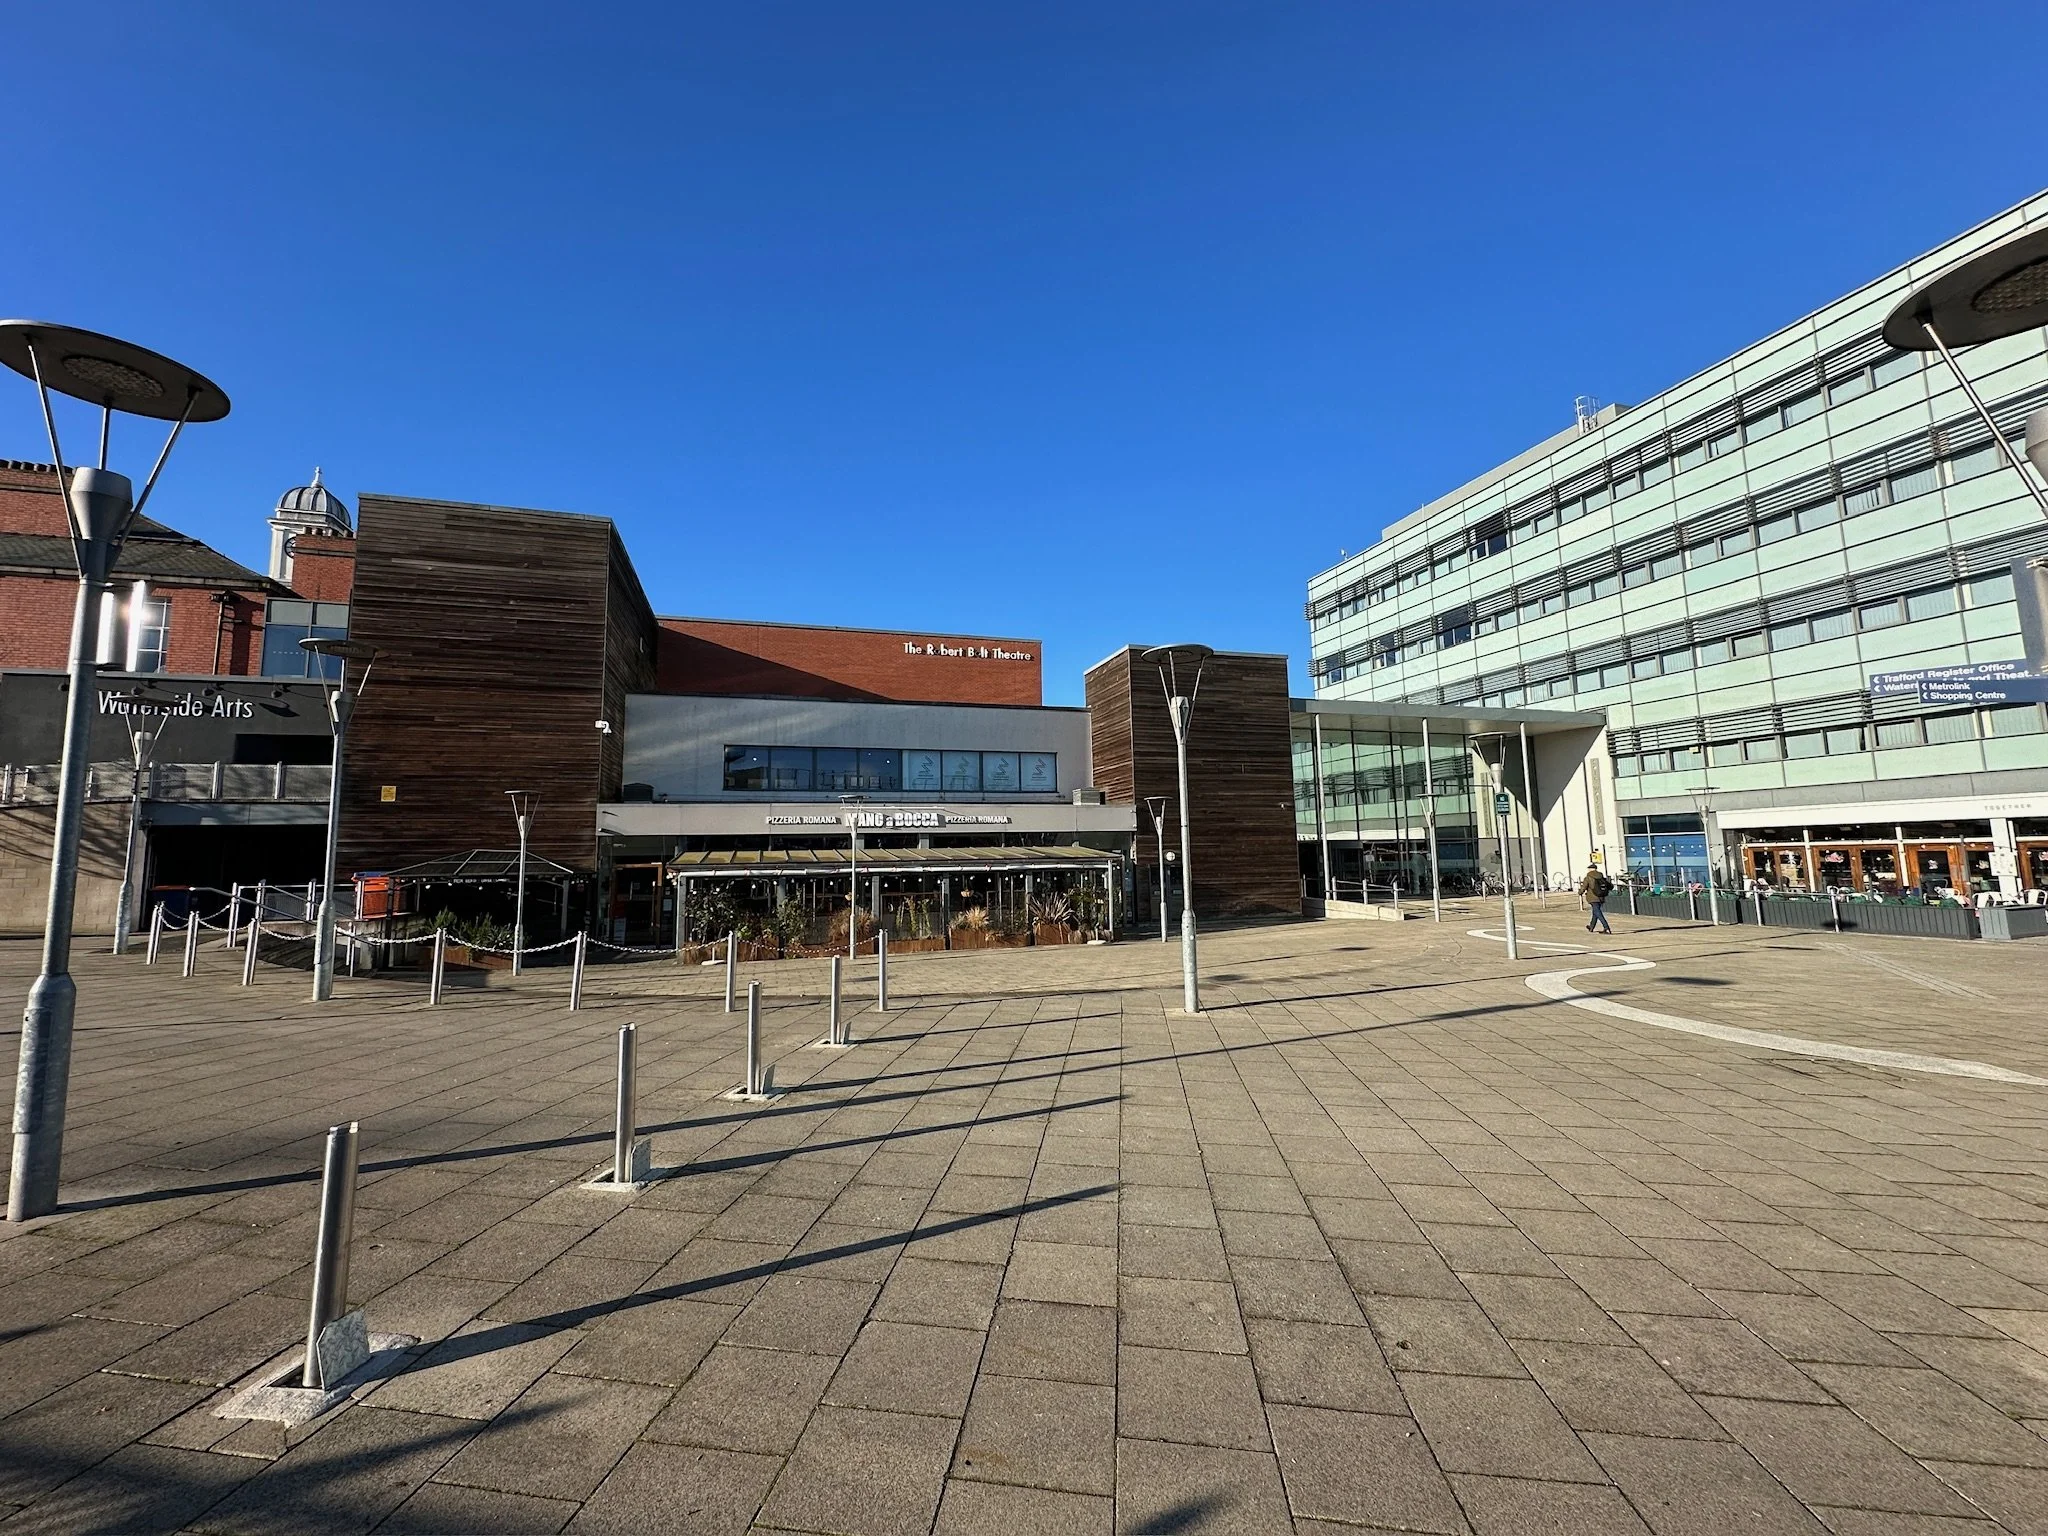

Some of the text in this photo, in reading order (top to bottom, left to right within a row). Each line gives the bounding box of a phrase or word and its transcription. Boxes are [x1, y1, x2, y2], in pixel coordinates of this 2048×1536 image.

[903, 641, 1031, 660] The Robert Bolt Theatre
[1882, 671, 1924, 683] Trafford
[1928, 667, 1976, 679] Register
[1978, 663, 2015, 673] Office
[1883, 682, 1919, 692] Water
[1993, 670, 2032, 681] Theat
[1929, 682, 1971, 691] Metrolink
[1930, 691, 2006, 701] Shopping Centre
[211, 695, 253, 718] Arts
[766, 815, 837, 824] PIZZERIA ROMANA
[845, 812, 884, 827] MANO
[895, 812, 939, 827] BOCCA
[946, 815, 1008, 824] PIZZERIA ROMANA
